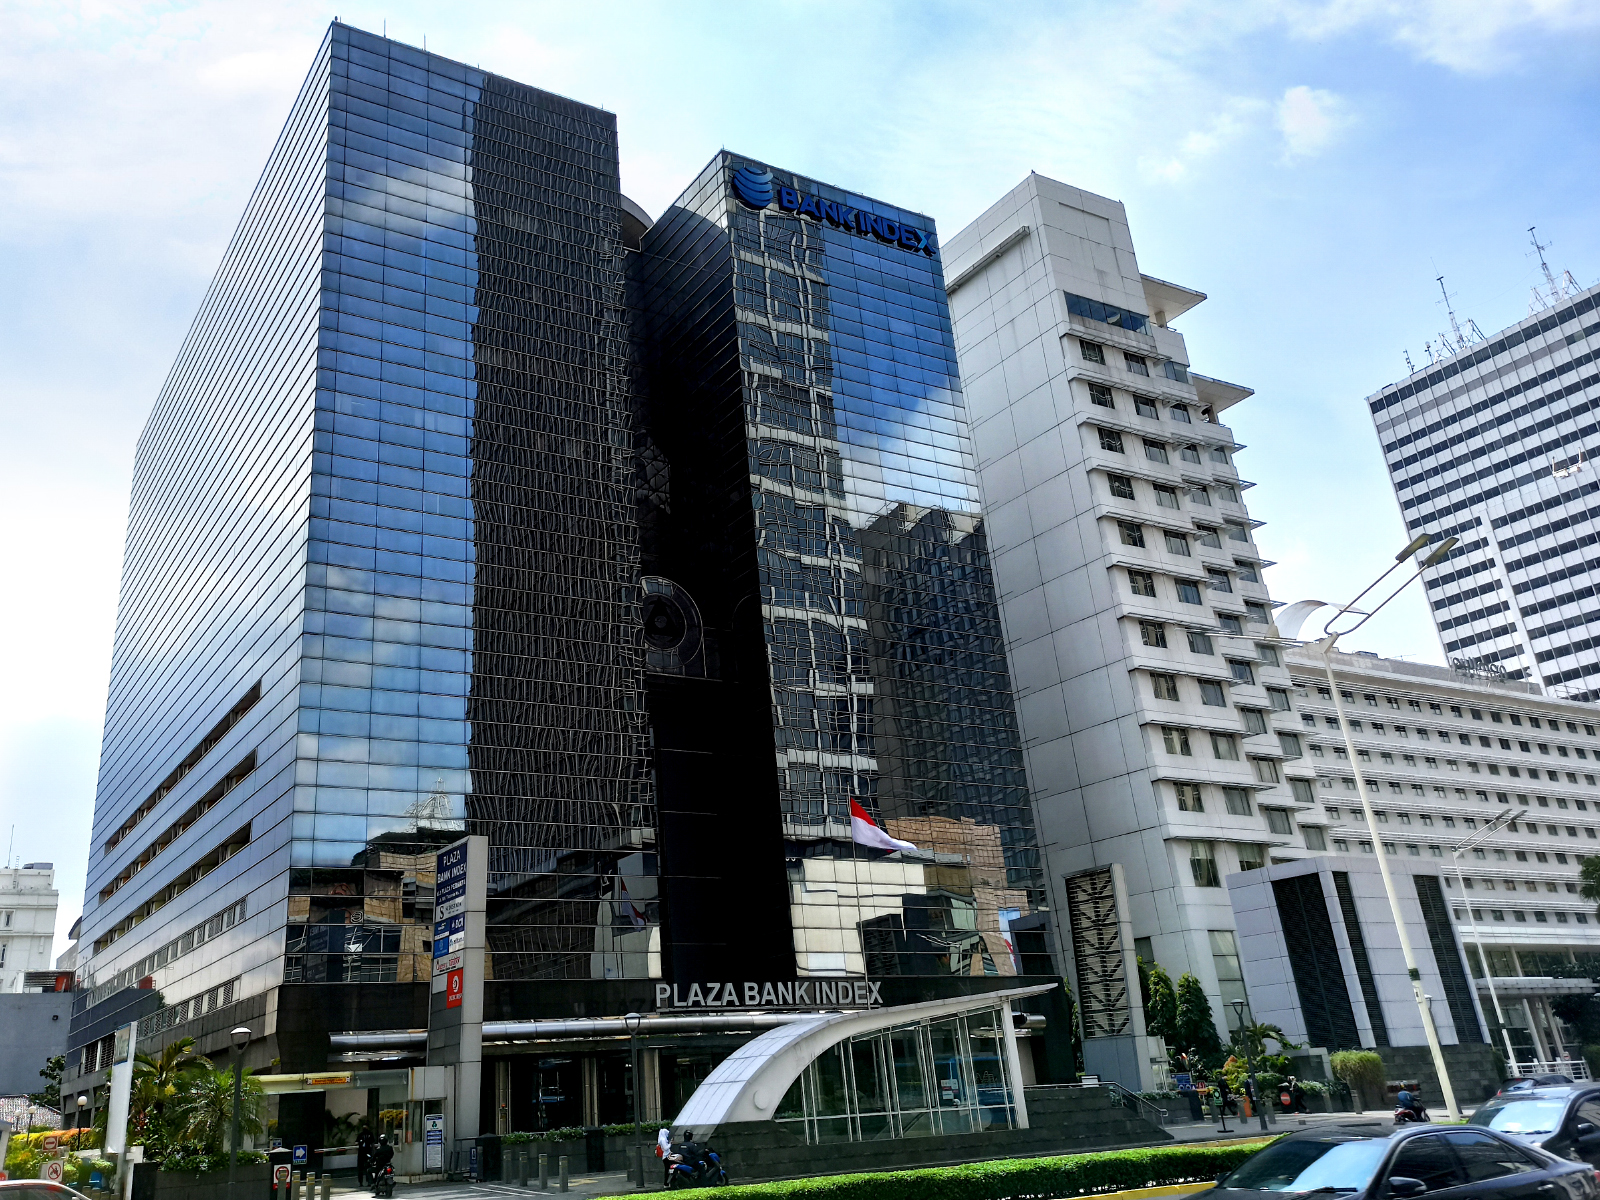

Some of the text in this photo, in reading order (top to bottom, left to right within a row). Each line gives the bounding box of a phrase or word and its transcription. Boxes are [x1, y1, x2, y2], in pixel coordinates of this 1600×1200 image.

[779, 186, 936, 256] BANK INDEX
[443, 850, 460, 867] PLAZA
[437, 862, 467, 884] BANK INDEX
[655, 981, 884, 1007] PLAZA BANK INDEX
